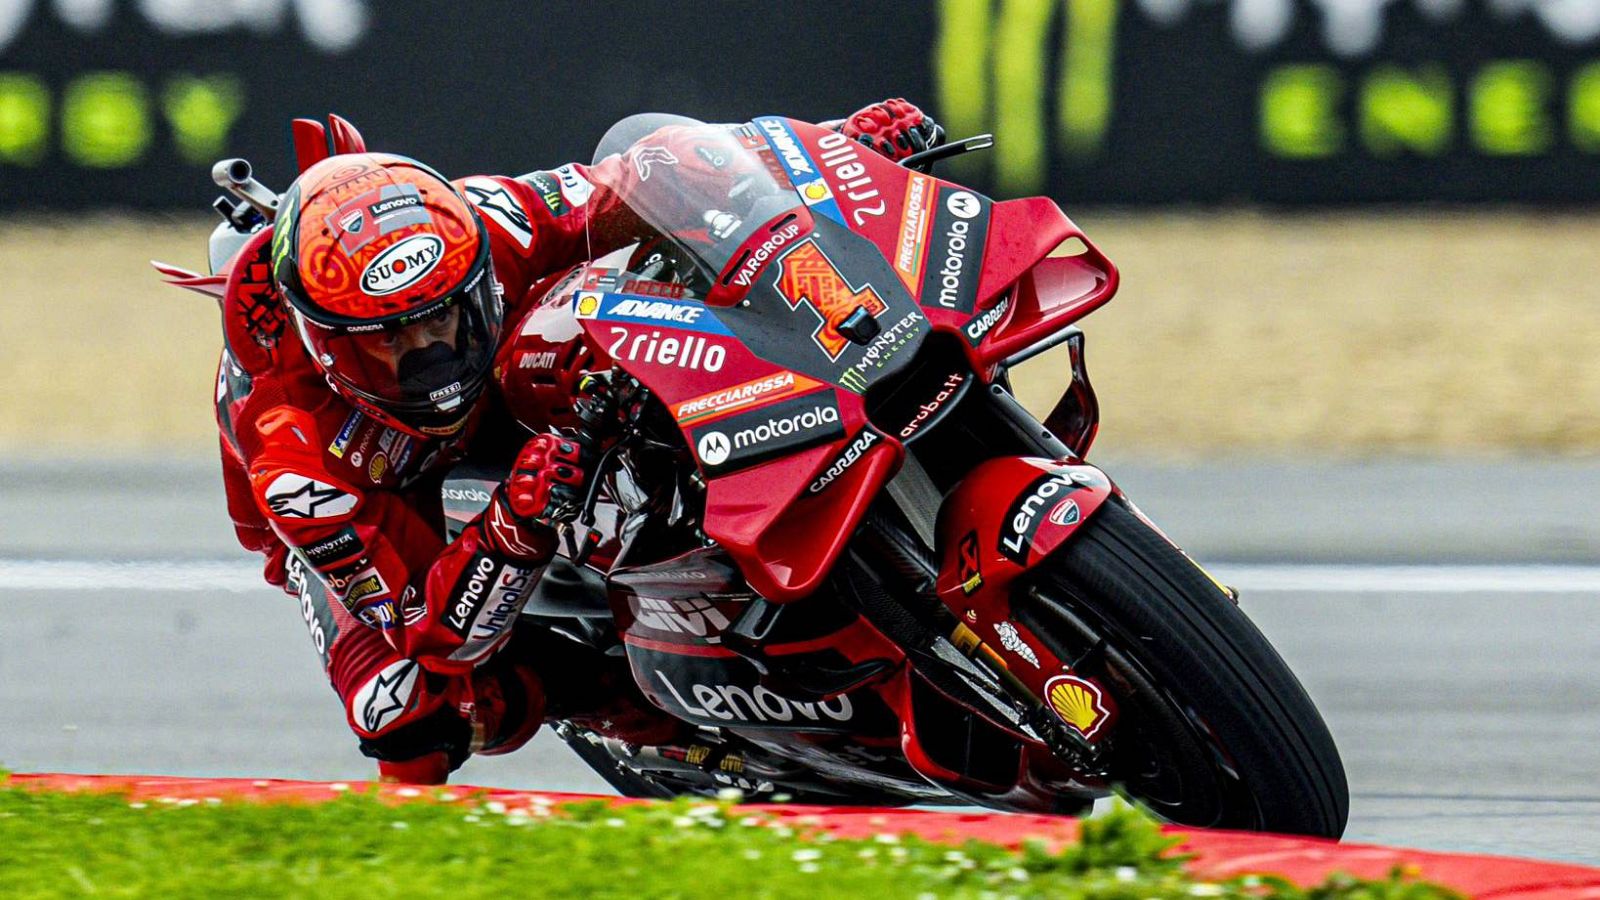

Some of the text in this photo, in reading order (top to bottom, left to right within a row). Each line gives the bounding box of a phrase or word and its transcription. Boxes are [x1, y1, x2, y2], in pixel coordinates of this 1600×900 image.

[371, 196, 418, 215] Lenovo
[899, 177, 926, 272] FRECCIAROSSA
[367, 245, 439, 284] SUOMY
[734, 224, 799, 288] VARGROUP
[938, 221, 969, 309] motorola
[607, 299, 705, 324] ADVANCE
[856, 311, 924, 372] MONSTER
[518, 353, 557, 369] DUCATI
[677, 373, 795, 418] FRECCIAROSSA
[900, 372, 964, 438] aruba.it
[733, 406, 838, 449] motorola
[809, 430, 878, 493] CARRERA
[1003, 472, 1092, 554] Lenovo
[449, 557, 495, 630] Lenovo
